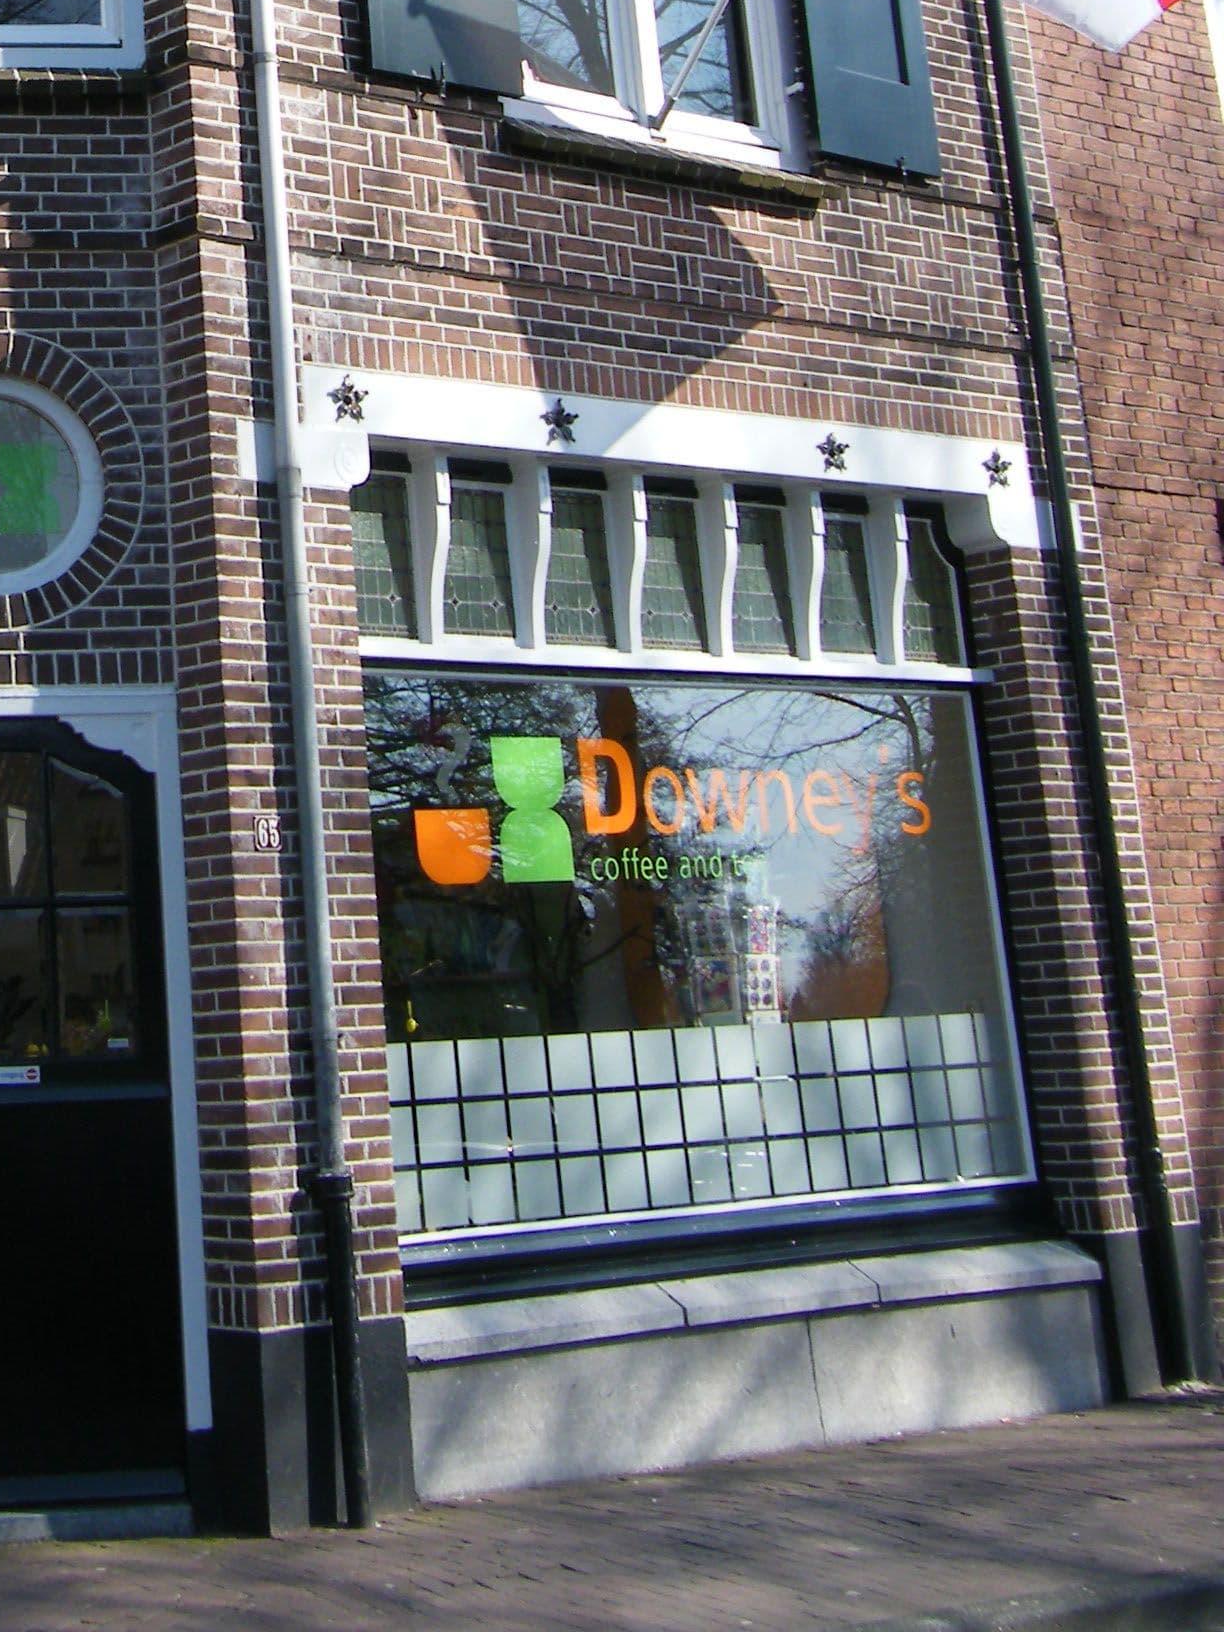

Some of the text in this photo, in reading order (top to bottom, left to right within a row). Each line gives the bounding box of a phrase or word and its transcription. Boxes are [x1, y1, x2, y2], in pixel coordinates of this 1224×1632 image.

[577, 738, 931, 855] Downey's
[258, 818, 280, 847] 65
[591, 848, 668, 881] coffee
[679, 848, 723, 879] and
